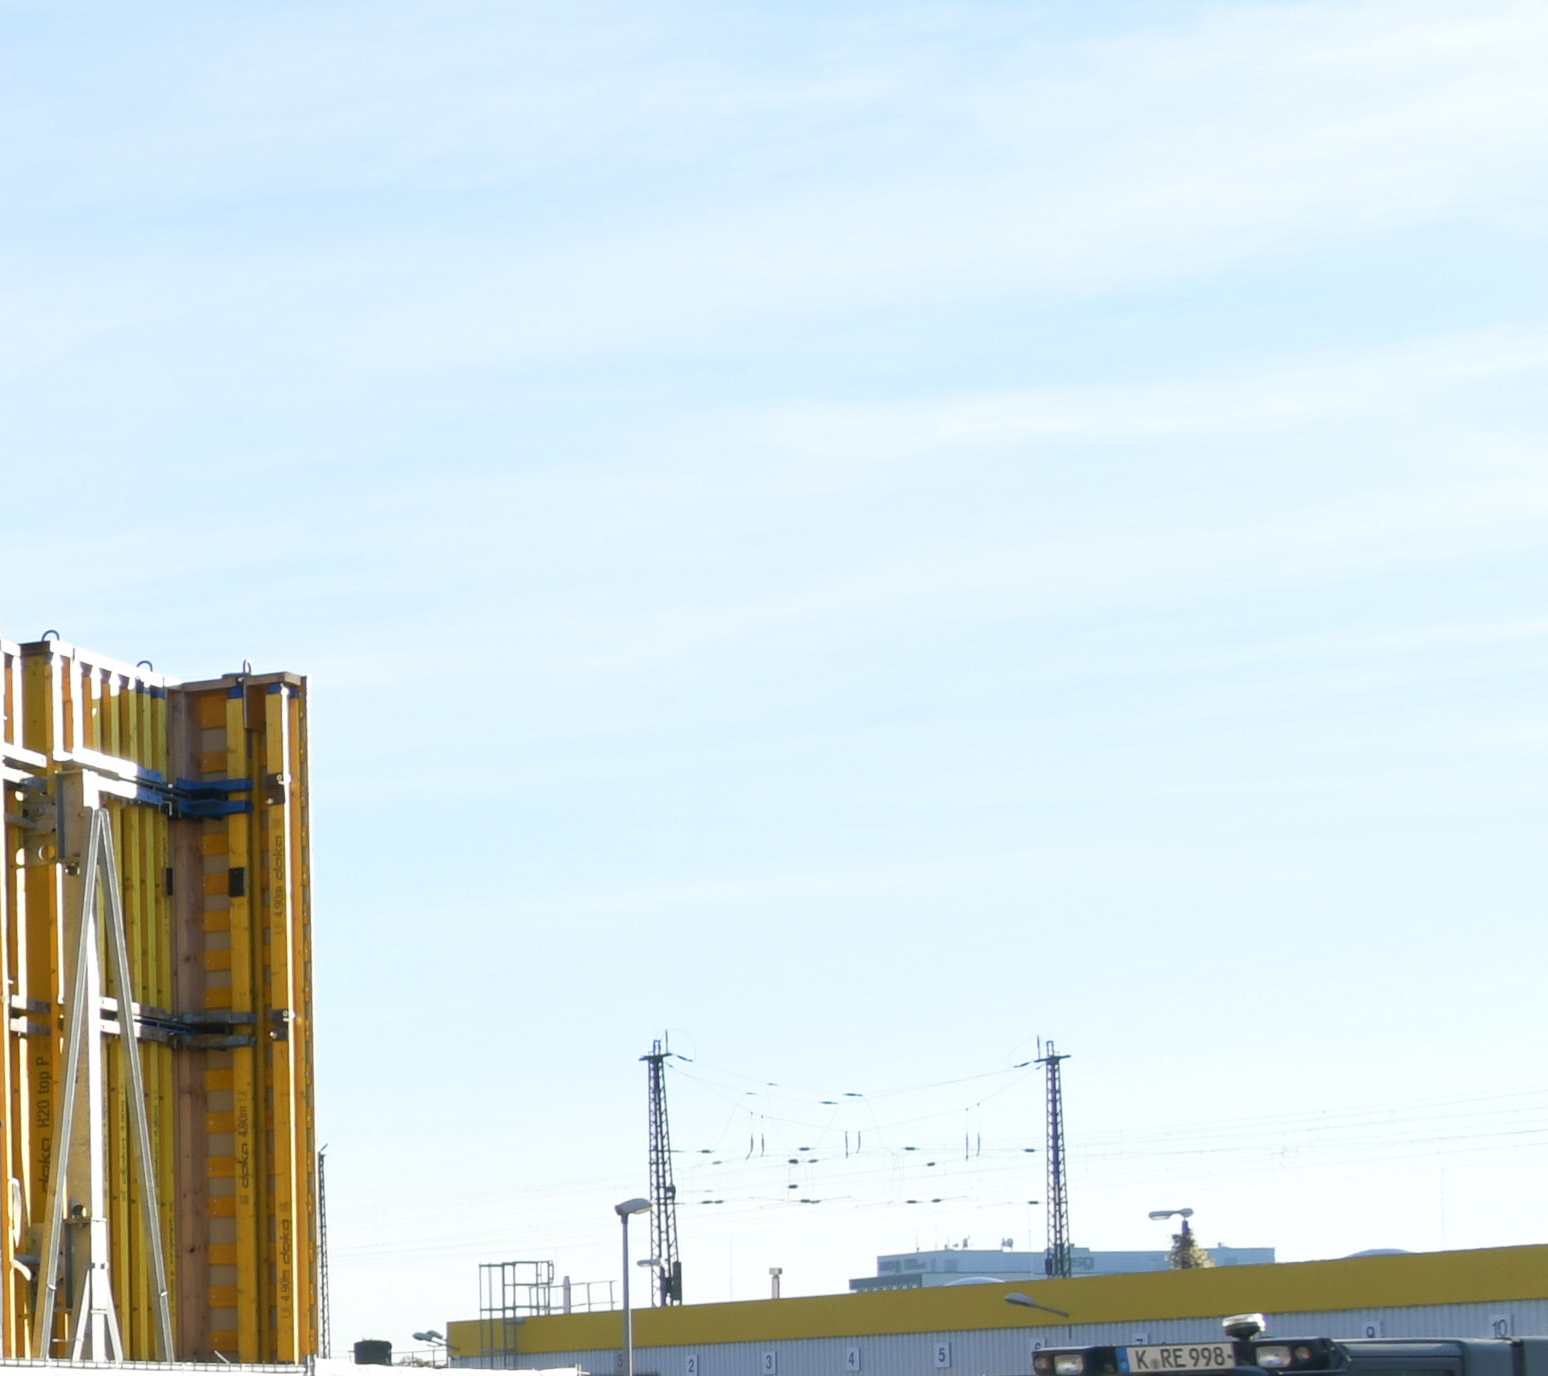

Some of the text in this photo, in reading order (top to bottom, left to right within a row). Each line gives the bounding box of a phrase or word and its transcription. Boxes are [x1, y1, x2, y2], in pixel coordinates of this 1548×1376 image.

[36, 1056, 51, 1195] doka H20 top P
[242, 1143, 250, 1189] doka
[282, 1218, 291, 1266] doka
[765, 1355, 772, 1370] 3
[848, 1352, 855, 1366] 4
[937, 1347, 946, 1363] 5
[1133, 1351, 1148, 1370] K
[1160, 1349, 1187, 1370] RE
[688, 1359, 695, 1373] 2
